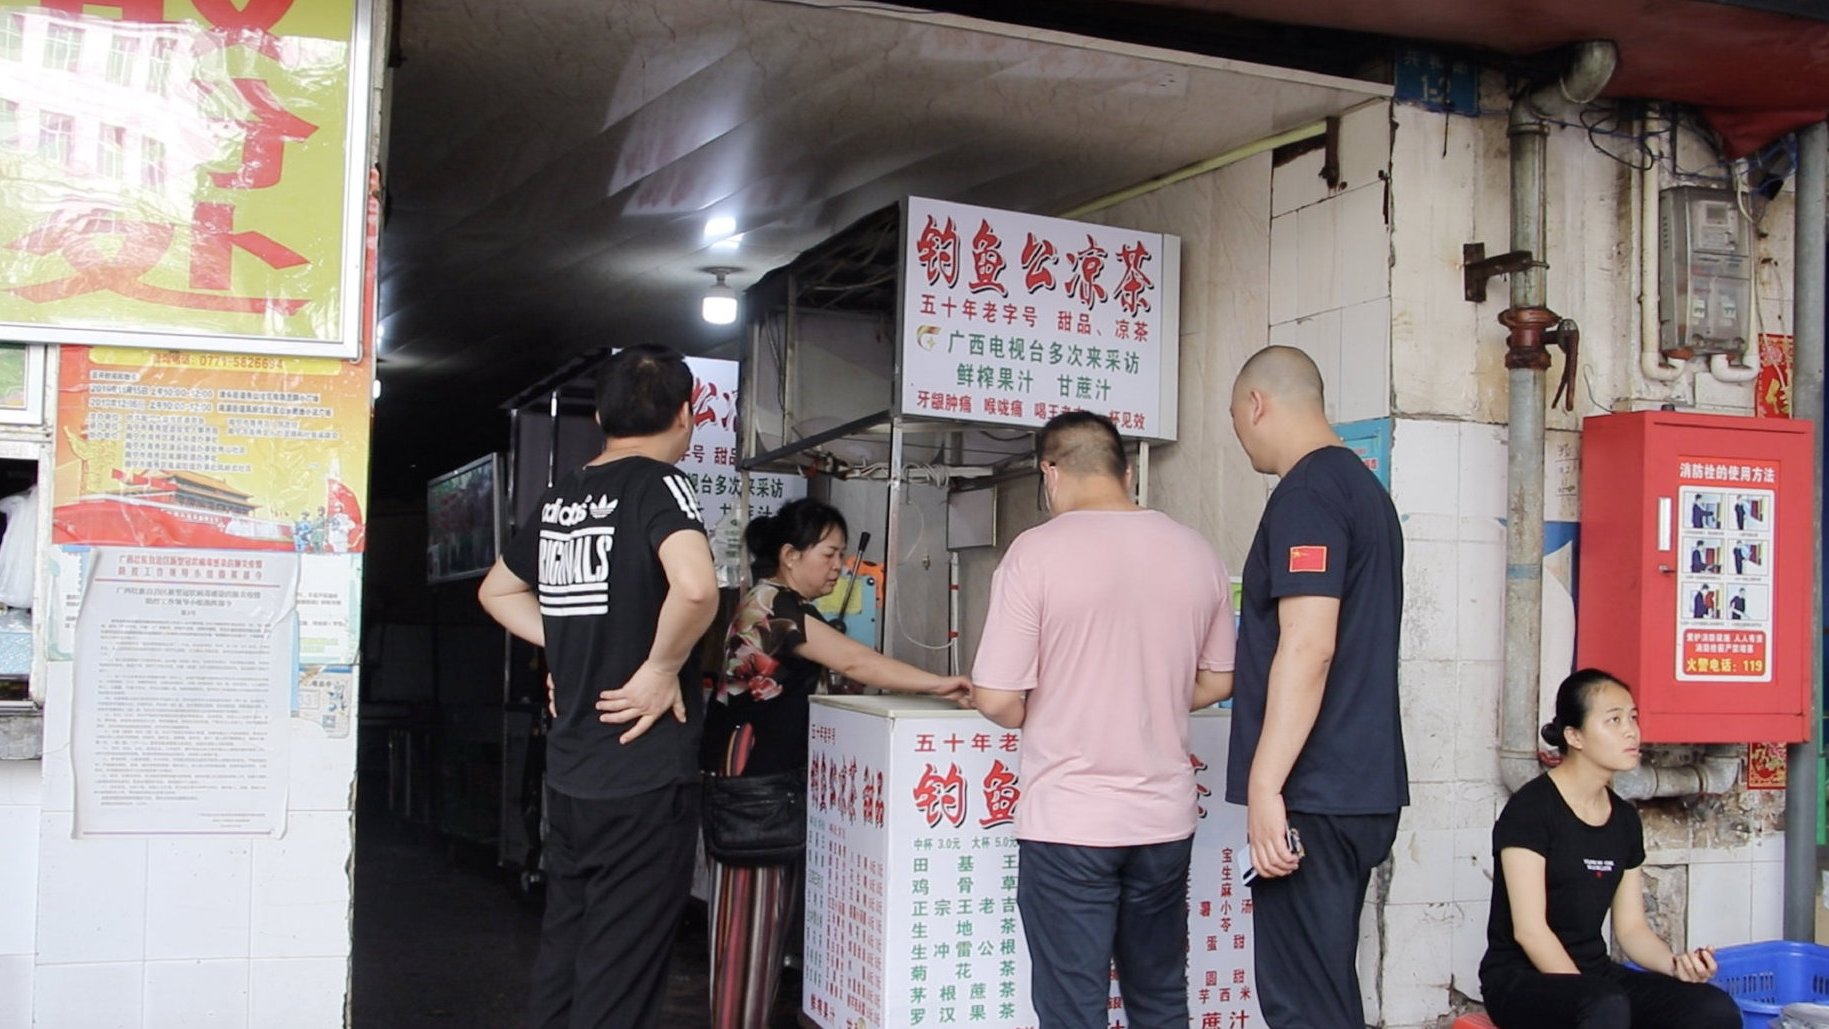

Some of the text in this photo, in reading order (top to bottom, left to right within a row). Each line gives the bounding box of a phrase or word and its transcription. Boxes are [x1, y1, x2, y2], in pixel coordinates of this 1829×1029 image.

[916, 214, 1155, 319] 钓鱼公凉茶
[920, 294, 1149, 342] 五十年老字号 甜品、凉茶
[948, 330, 1140, 374] 广西电视台多次来采访
[956, 363, 1112, 401] 鲜榨果汁 甘蔗汁
[916, 390, 973, 413] 牙龈肿痛
[984, 398, 1023, 418] 喉咙痛
[1679, 463, 1775, 483] 消防栓的使用方法
[914, 732, 1020, 753] 五十年老
[913, 758, 1021, 830] 钓鱼
